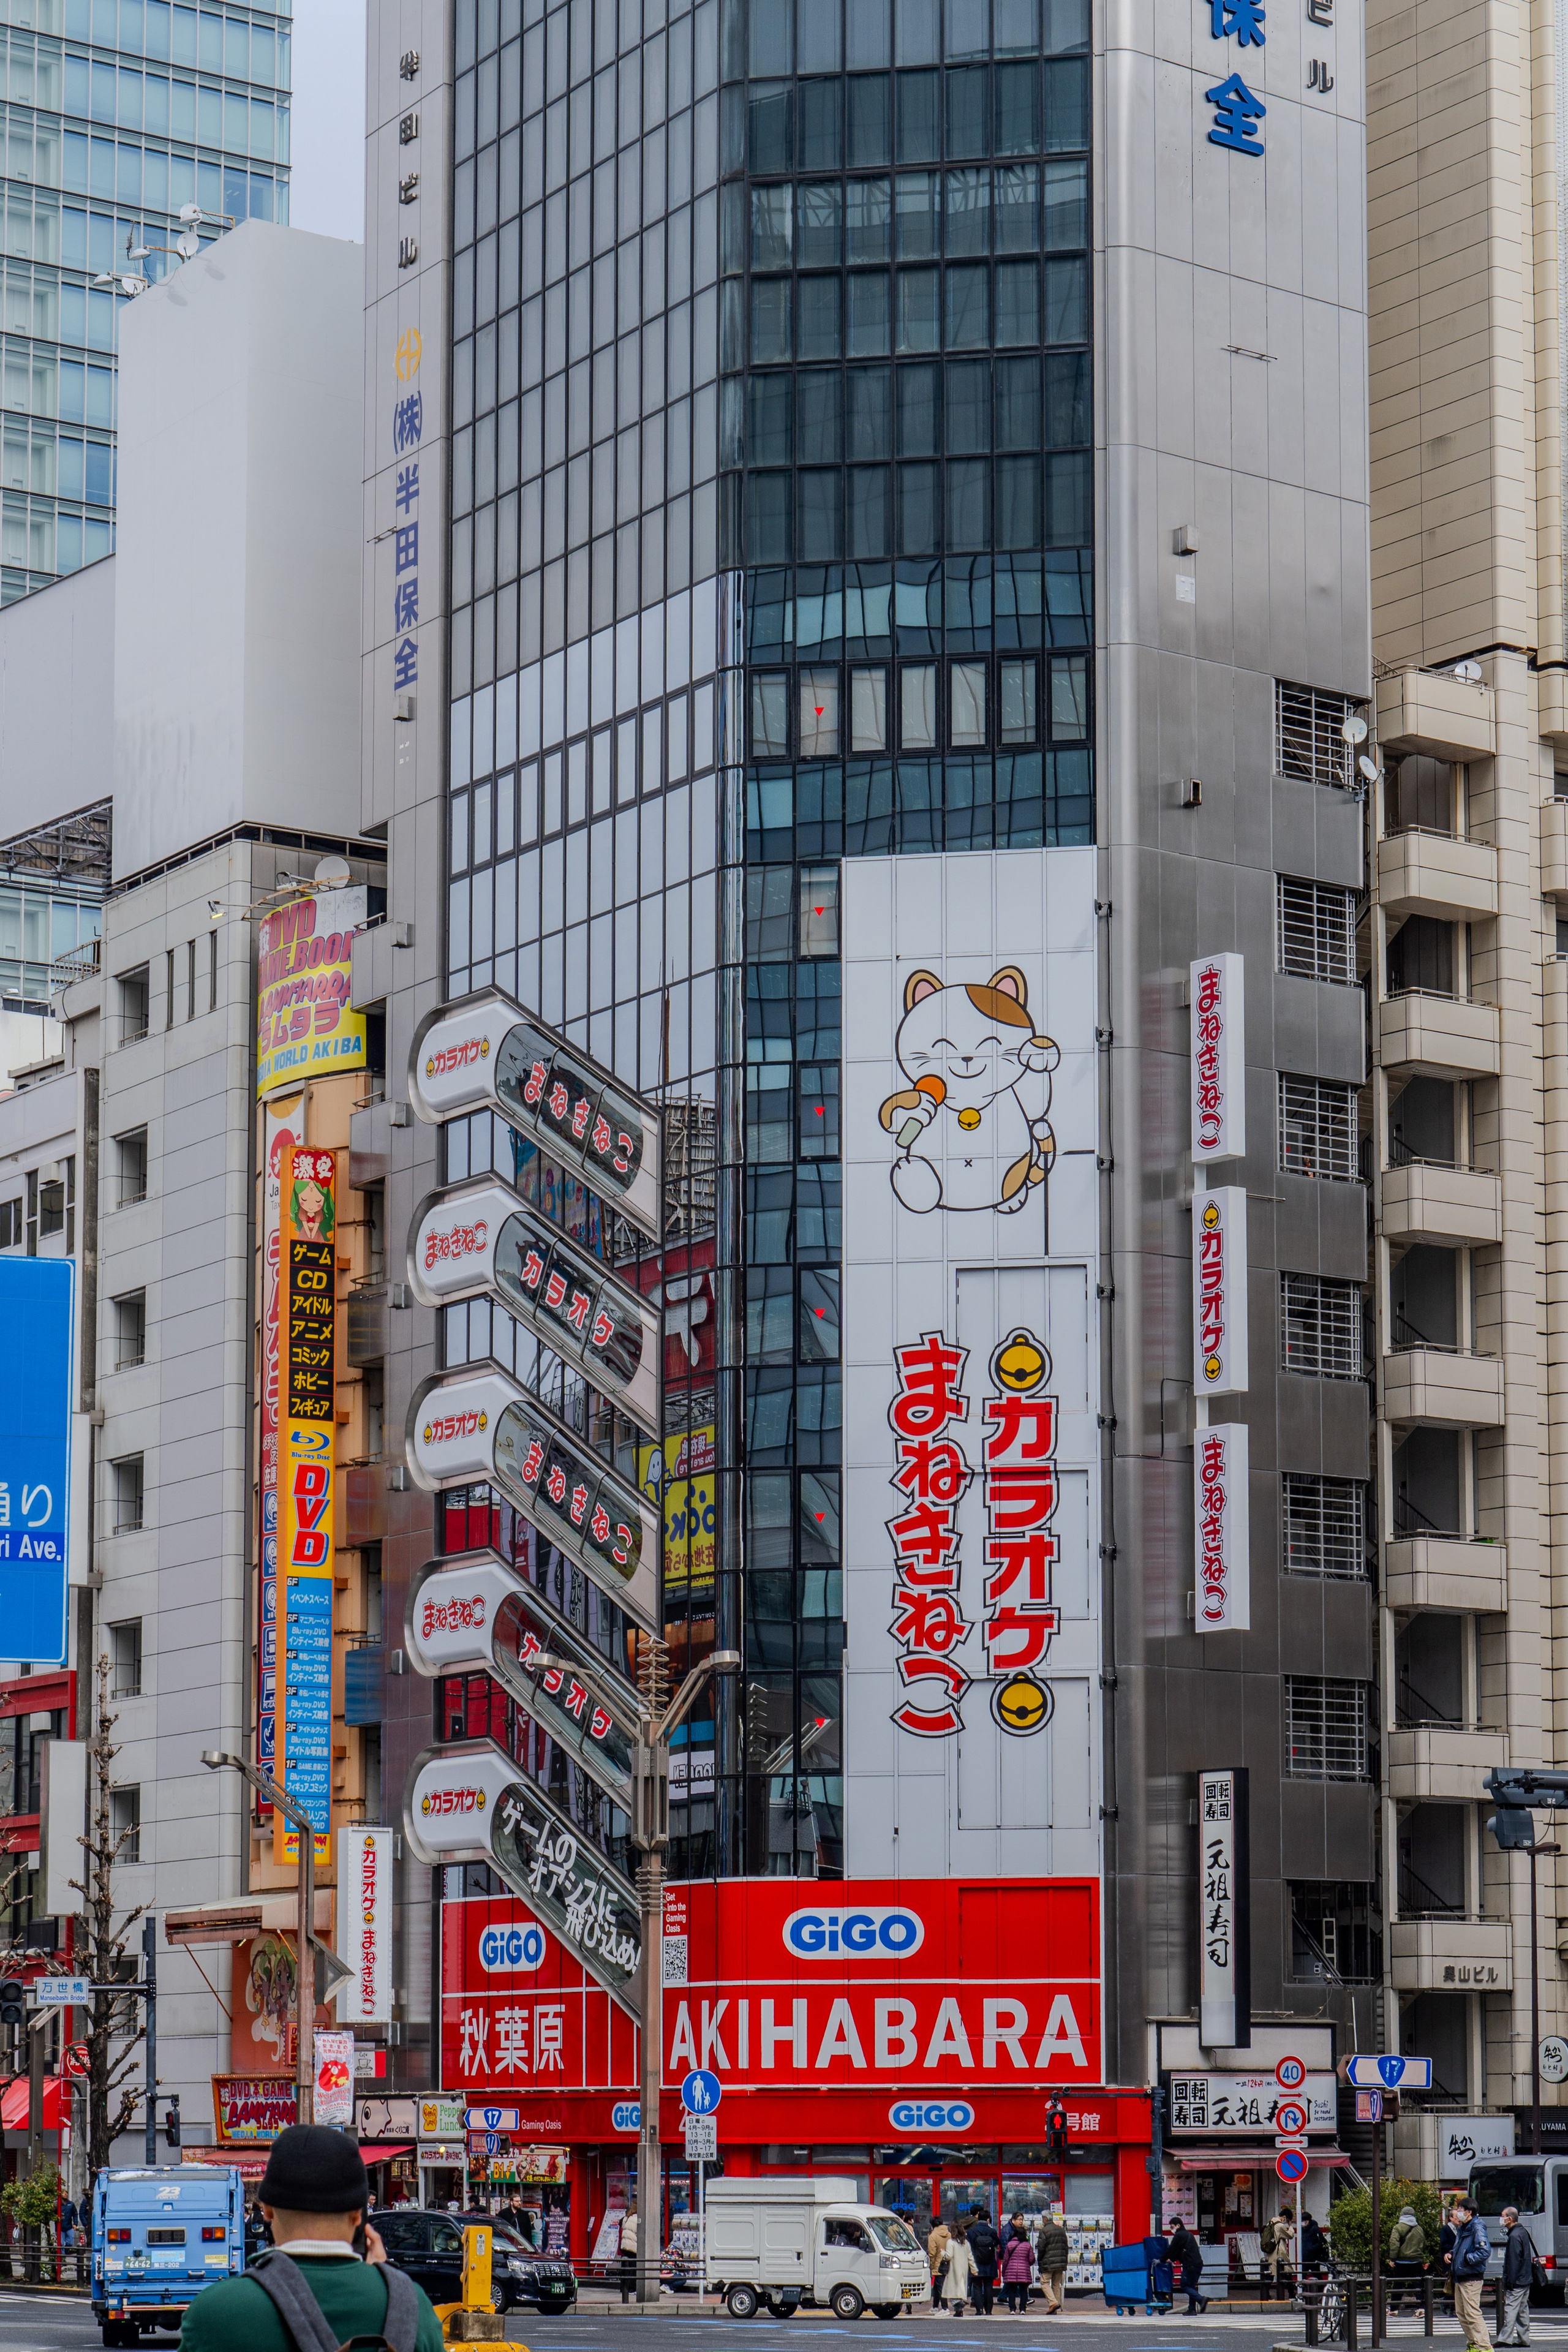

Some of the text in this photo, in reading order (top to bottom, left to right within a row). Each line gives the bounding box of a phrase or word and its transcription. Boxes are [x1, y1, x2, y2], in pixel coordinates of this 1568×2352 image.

[398, 50, 419, 270] 半田ビル
[270, 899, 317, 951] DVD
[261, 999, 341, 1057] ラムタラ
[274, 1045, 308, 1072] WORLD
[313, 1035, 362, 1061] AKIBA
[434, 1039, 481, 1076] カラオケ
[1196, 962, 1223, 1151] まねきねこ
[524, 1060, 634, 1172] まねきねこ
[293, 1154, 334, 1180] 激安
[293, 1243, 331, 1266] ゲーム
[424, 1219, 489, 1270] まねきねこ
[296, 1270, 328, 1289] CD
[520, 1248, 615, 1347] カラオケ
[1199, 1227, 1223, 1356] カラオケ
[292, 1295, 332, 1315] アイドル
[291, 1320, 333, 1341] アニメ
[292, 1346, 330, 1366] コミック
[293, 1371, 329, 1390] ホビー
[292, 1397, 330, 1417] フィギュア
[432, 1409, 478, 1444] カラオケ
[522, 1439, 633, 1564] まねきねこ
[291, 1462, 331, 1567] DVD
[884, 1330, 975, 1738] まねきねこ
[982, 1395, 1061, 1677] カラオケ
[1199, 1432, 1228, 1623] まねきねこ
[18, 1534, 61, 1561] Ave.
[287, 1577, 299, 1586] 6F
[287, 1613, 298, 1623] 5F
[421, 1594, 487, 1641] まねきねこ
[286, 1650, 297, 1659] 4F
[286, 1686, 297, 1695] 3F
[285, 1723, 296, 1732] 2F
[285, 1760, 296, 1768] 1F
[1205, 1781, 1231, 1800] 回転
[430, 1787, 477, 1817] カラオケ
[1205, 1802, 1231, 1820] 寿司
[502, 1796, 577, 1871] ゲームの
[362, 1848, 377, 1912] カラオケ
[666, 1893, 676, 1901] Get
[667, 1902, 686, 1912] into the
[1204, 1838, 1231, 1968] 元祖寿司
[666, 1913, 686, 1923] Gaming
[666, 1924, 680, 1932] Oasis
[790, 1914, 918, 1952] GiGO
[485, 1929, 543, 1966] GiGO
[360, 1926, 377, 2016] まねきねこ
[1442, 1964, 1499, 1983] 奥山ビル
[42, 1982, 84, 1994] 万世橋
[70, 1994, 86, 2002] Bridge
[459, 2003, 565, 2076] 秋葉原
[669, 1994, 1089, 2070] AKIHABARA
[1283, 2065, 1299, 2080] 40
[1174, 2081, 1206, 2102] 回転
[439, 2104, 460, 2117] Peppe
[1314, 2100, 1329, 2108] Sushi
[1371, 2095, 1378, 2114] 17
[487, 2111, 499, 2125] 17
[521, 2119, 562, 2132] Gaming Oasis
[614, 2105, 641, 2128] GiG
[892, 2105, 972, 2128] GiGO
[1174, 2105, 1206, 2125] 寿司
[231, 2130, 279, 2139] MEDIA WORLD
[1531, 2122, 1567, 2132] UYAMA
[487, 2136, 494, 2149] 17
[493, 2162, 504, 2179] B1
[157, 2186, 181, 2196] 23
